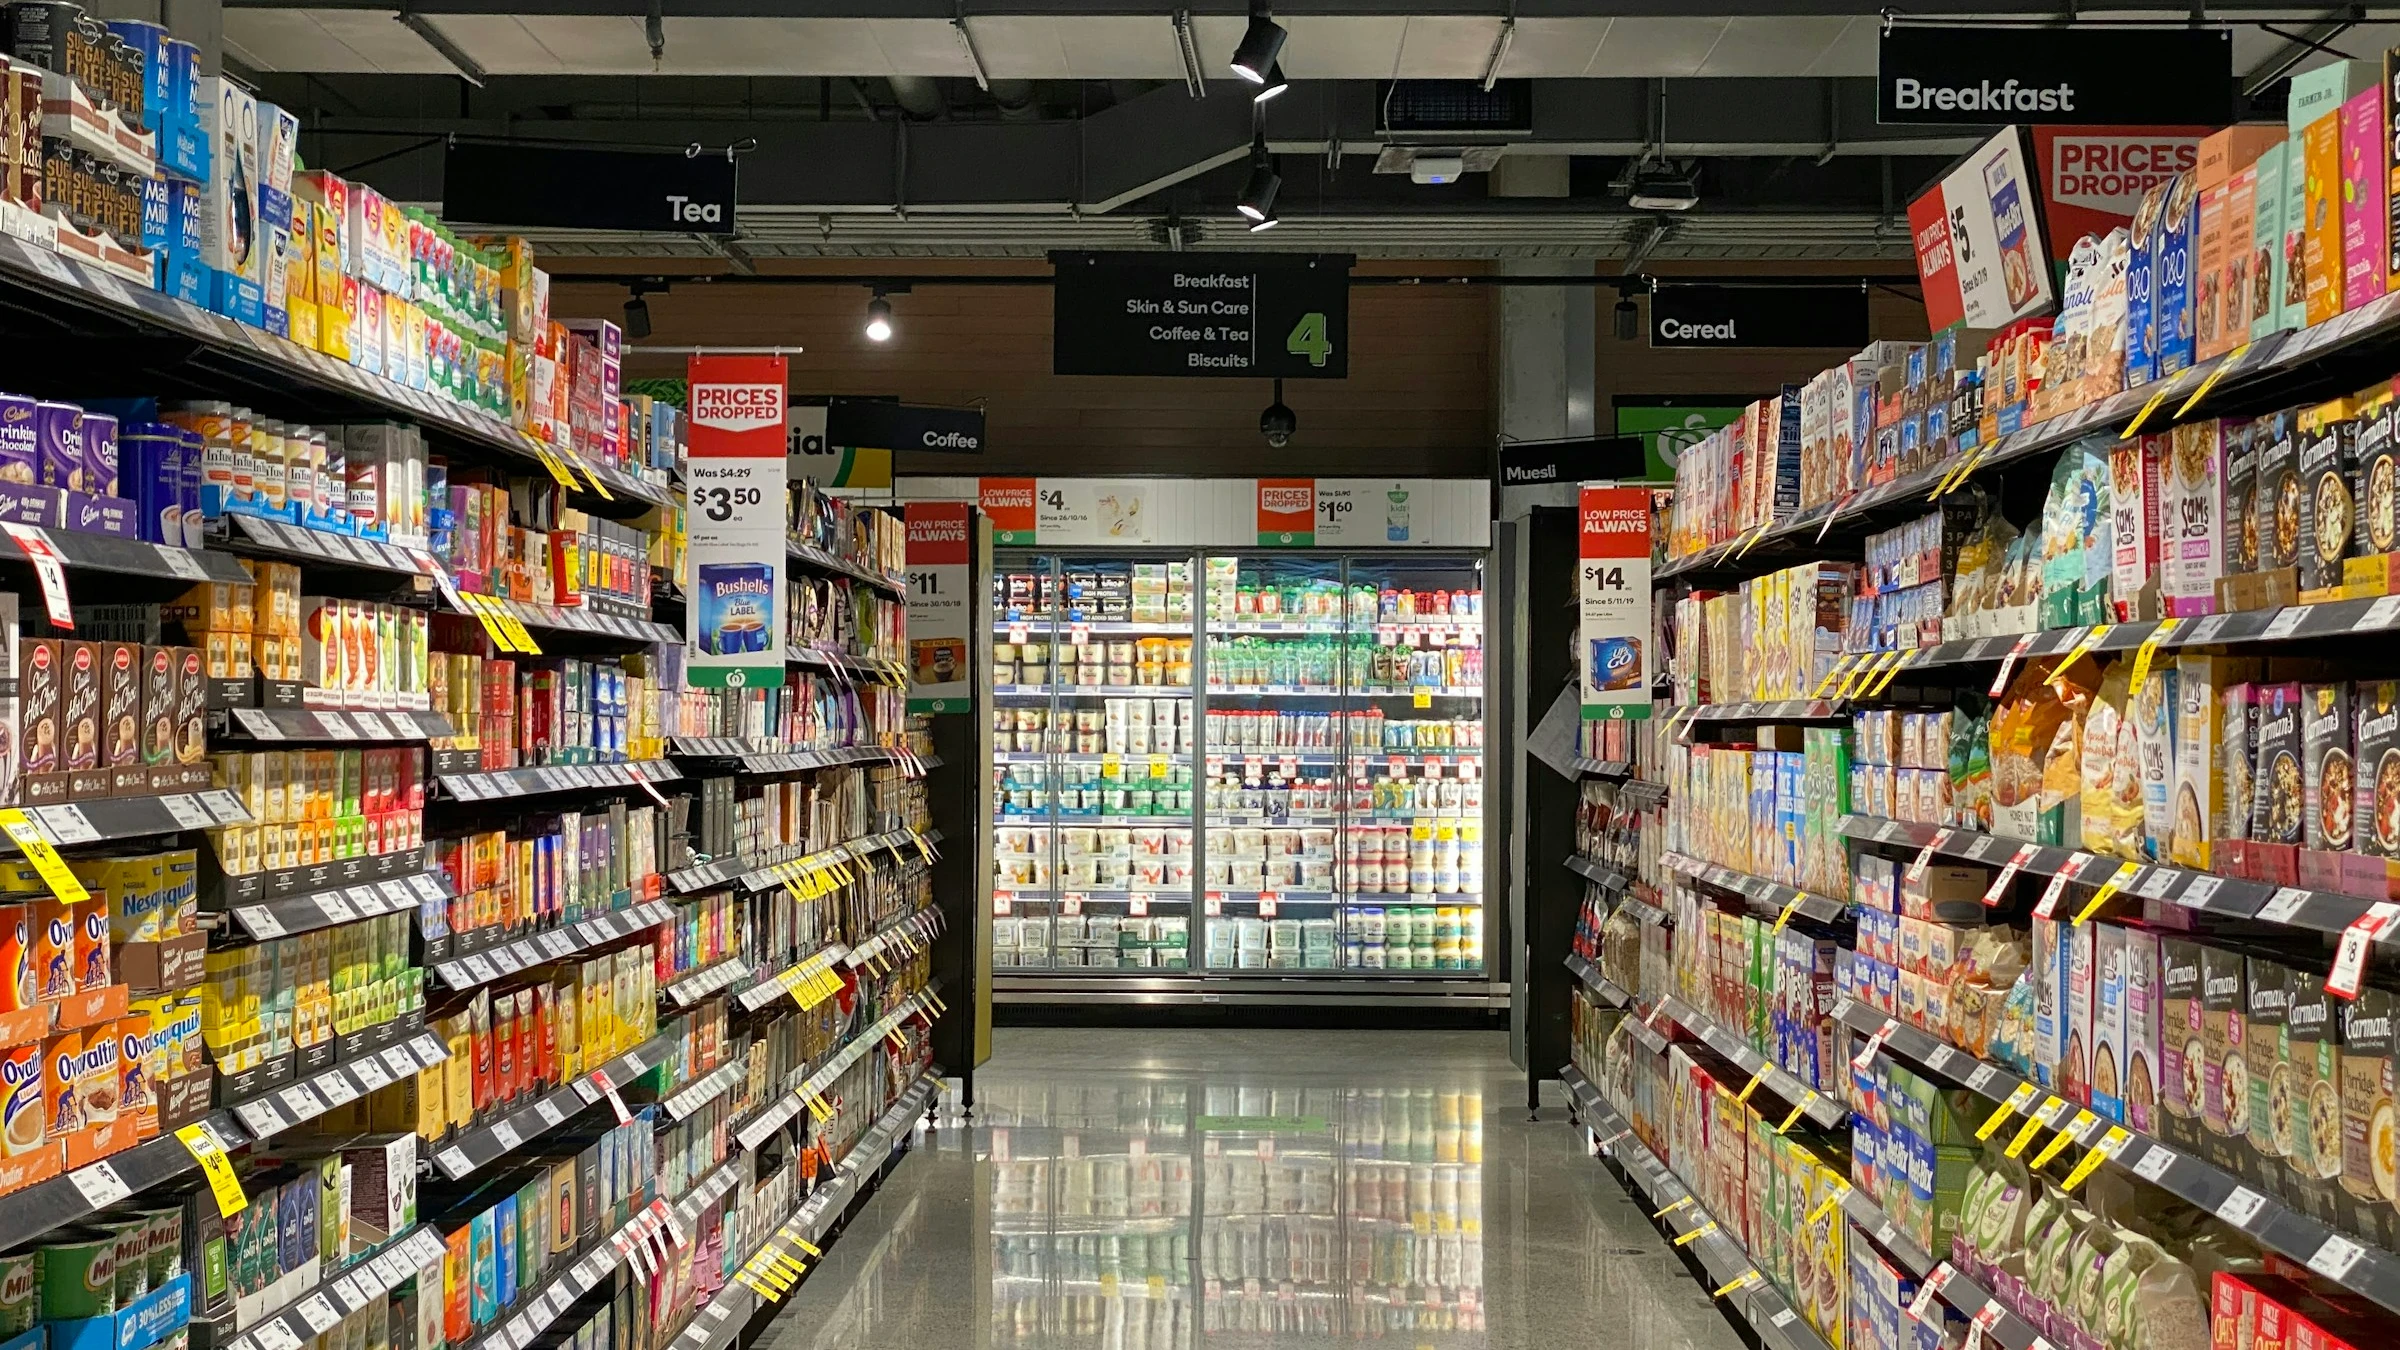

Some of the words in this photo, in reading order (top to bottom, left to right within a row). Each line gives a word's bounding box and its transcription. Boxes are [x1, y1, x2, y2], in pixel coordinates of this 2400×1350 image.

[1896, 78, 2075, 111] Breakfast
[177, 134, 196, 155] Malted
[2060, 144, 2197, 172] PRICES
[666, 195, 721, 222] Tea
[145, 221, 165, 237] Drink
[1917, 226, 1931, 252] LOW
[1929, 216, 1947, 239] PRICE
[1950, 205, 1971, 263] $5
[1922, 239, 1951, 279] ALWAYS
[1173, 273, 1249, 289] Breakfast
[1962, 275, 1974, 295] Since
[1126, 300, 1159, 315] Skin
[1162, 301, 1174, 314] &
[1178, 301, 1208, 315] Sun
[1211, 301, 1249, 315] Care
[1149, 326, 1200, 341] Coffee
[1204, 327, 1216, 341] &
[1218, 327, 1249, 341] Tea
[1286, 312, 1332, 367] 4
[1660, 318, 1737, 340] Cereal
[1188, 353, 1248, 368] Biscuits
[697, 388, 778, 406] PRICES
[3, 406, 33, 422] Cadbury
[697, 407, 778, 420] DROPPED
[0, 424, 36, 440] rinking
[922, 431, 978, 449] Coffee
[2355, 407, 2393, 458] Carman's
[2299, 427, 2338, 473] Carman's
[694, 468, 718, 478] Was
[720, 468, 752, 478] $4.29
[1506, 464, 1557, 481] Muesli
[982, 497, 1033, 508] ALWAYS
[983, 489, 1004, 497] LOW
[1006, 489, 1032, 497] PRICE
[1040, 490, 1064, 511] $4
[1264, 490, 1309, 500] PRICES
[1264, 500, 1309, 508] DROPPED
[1584, 510, 1611, 519] LOW
[1613, 510, 1646, 519] PRICE
[21, 510, 41, 522] CHOCOLATE
[81, 505, 100, 527] Cadbury
[908, 520, 932, 529] LOW
[935, 520, 965, 529] PRICE
[1584, 520, 1647, 533] ALWAYS
[908, 530, 966, 542] ALWAYS
[45, 566, 59, 590] $4
[715, 576, 769, 598] Bushells
[909, 572, 937, 595] $11
[1585, 567, 1625, 591] $14
[730, 606, 756, 617] LABEL
[734, 599, 751, 607] Blue
[1607, 653, 1632, 669] GO
[24, 695, 42, 729] Hot
[40, 685, 57, 715] Choc
[66, 694, 82, 728] Hot
[80, 686, 97, 714] Choc
[108, 693, 123, 726] Hot
[121, 685, 137, 713] Choc
[146, 695, 161, 727] Hot
[158, 686, 173, 713] Choc
[178, 694, 193, 725] Hot
[190, 688, 206, 713] Choc
[2357, 705, 2398, 744] Carman's
[2023, 812, 2034, 823] NUT
[2017, 823, 2035, 836] CRUNCH
[2164, 956, 2198, 987] Carman's
[2204, 966, 2239, 998] Carman's
[2288, 992, 2327, 1026] Carman's
[2343, 1063, 2376, 1098] Porridge
[2344, 1087, 2371, 1115] Sachets
[193, 1138, 211, 1151] Special
[1853, 1126, 1874, 1159] Weet-Bix
[1887, 1132, 1908, 1174] Weet-Bix
[1909, 1149, 1933, 1194] Weet-Bix
[2219, 1281, 2234, 1299] UNCLE
[2262, 1301, 2280, 1323] UNCLE
[217, 1325, 225, 1336] Tea
[224, 1322, 234, 1334] Bags
[2214, 1314, 2235, 1347] OATS
[2296, 1323, 2313, 1347] UNCLE
